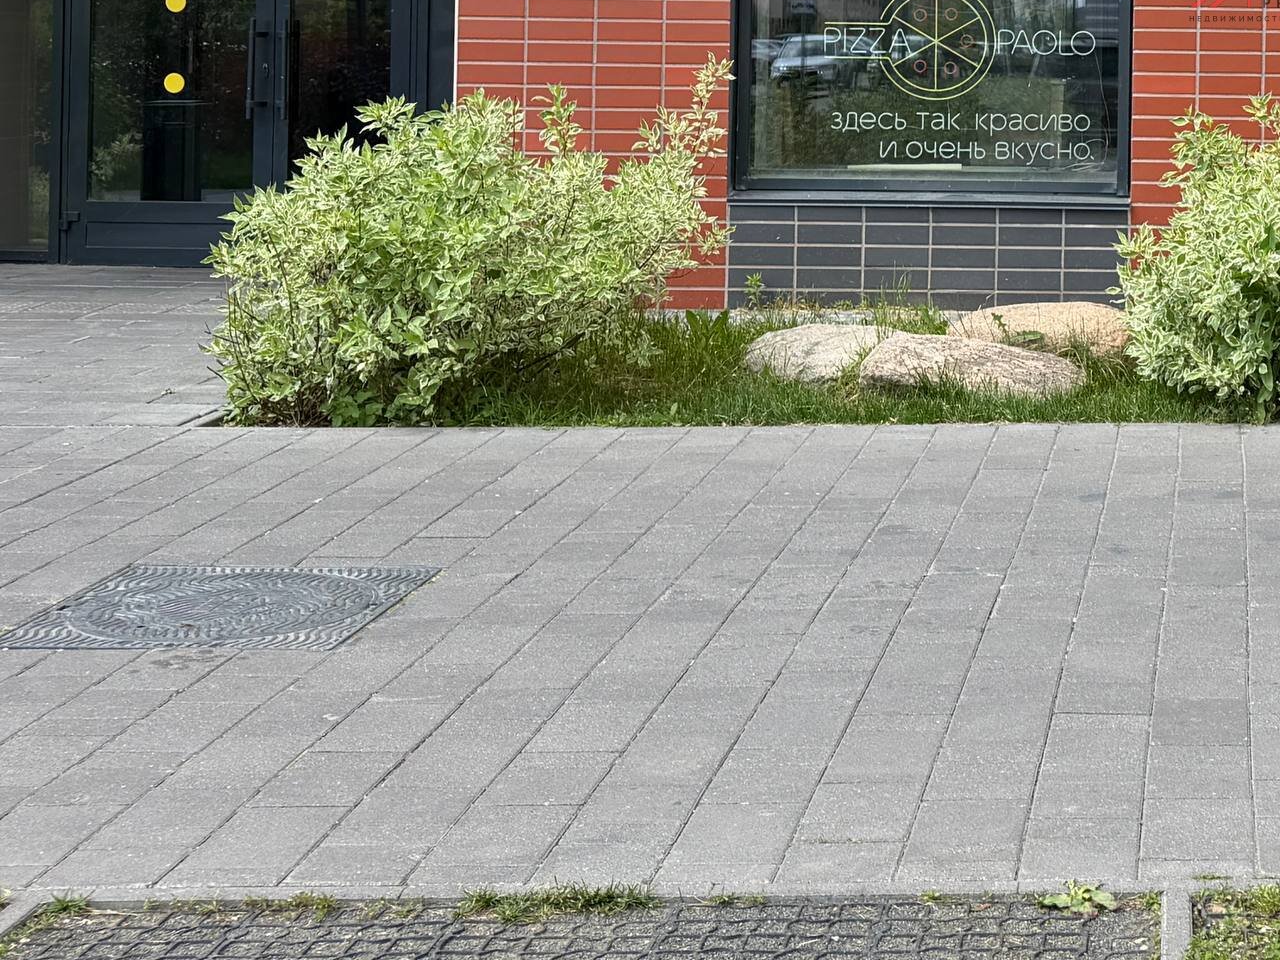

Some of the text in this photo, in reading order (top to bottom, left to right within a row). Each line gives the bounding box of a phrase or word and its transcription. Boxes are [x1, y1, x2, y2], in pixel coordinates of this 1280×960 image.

[823, 27, 1096, 56] PIZZA PAOLO
[831, 111, 1091, 136] здесь так красиво
[879, 141, 897, 159] и
[905, 140, 986, 159] очень
